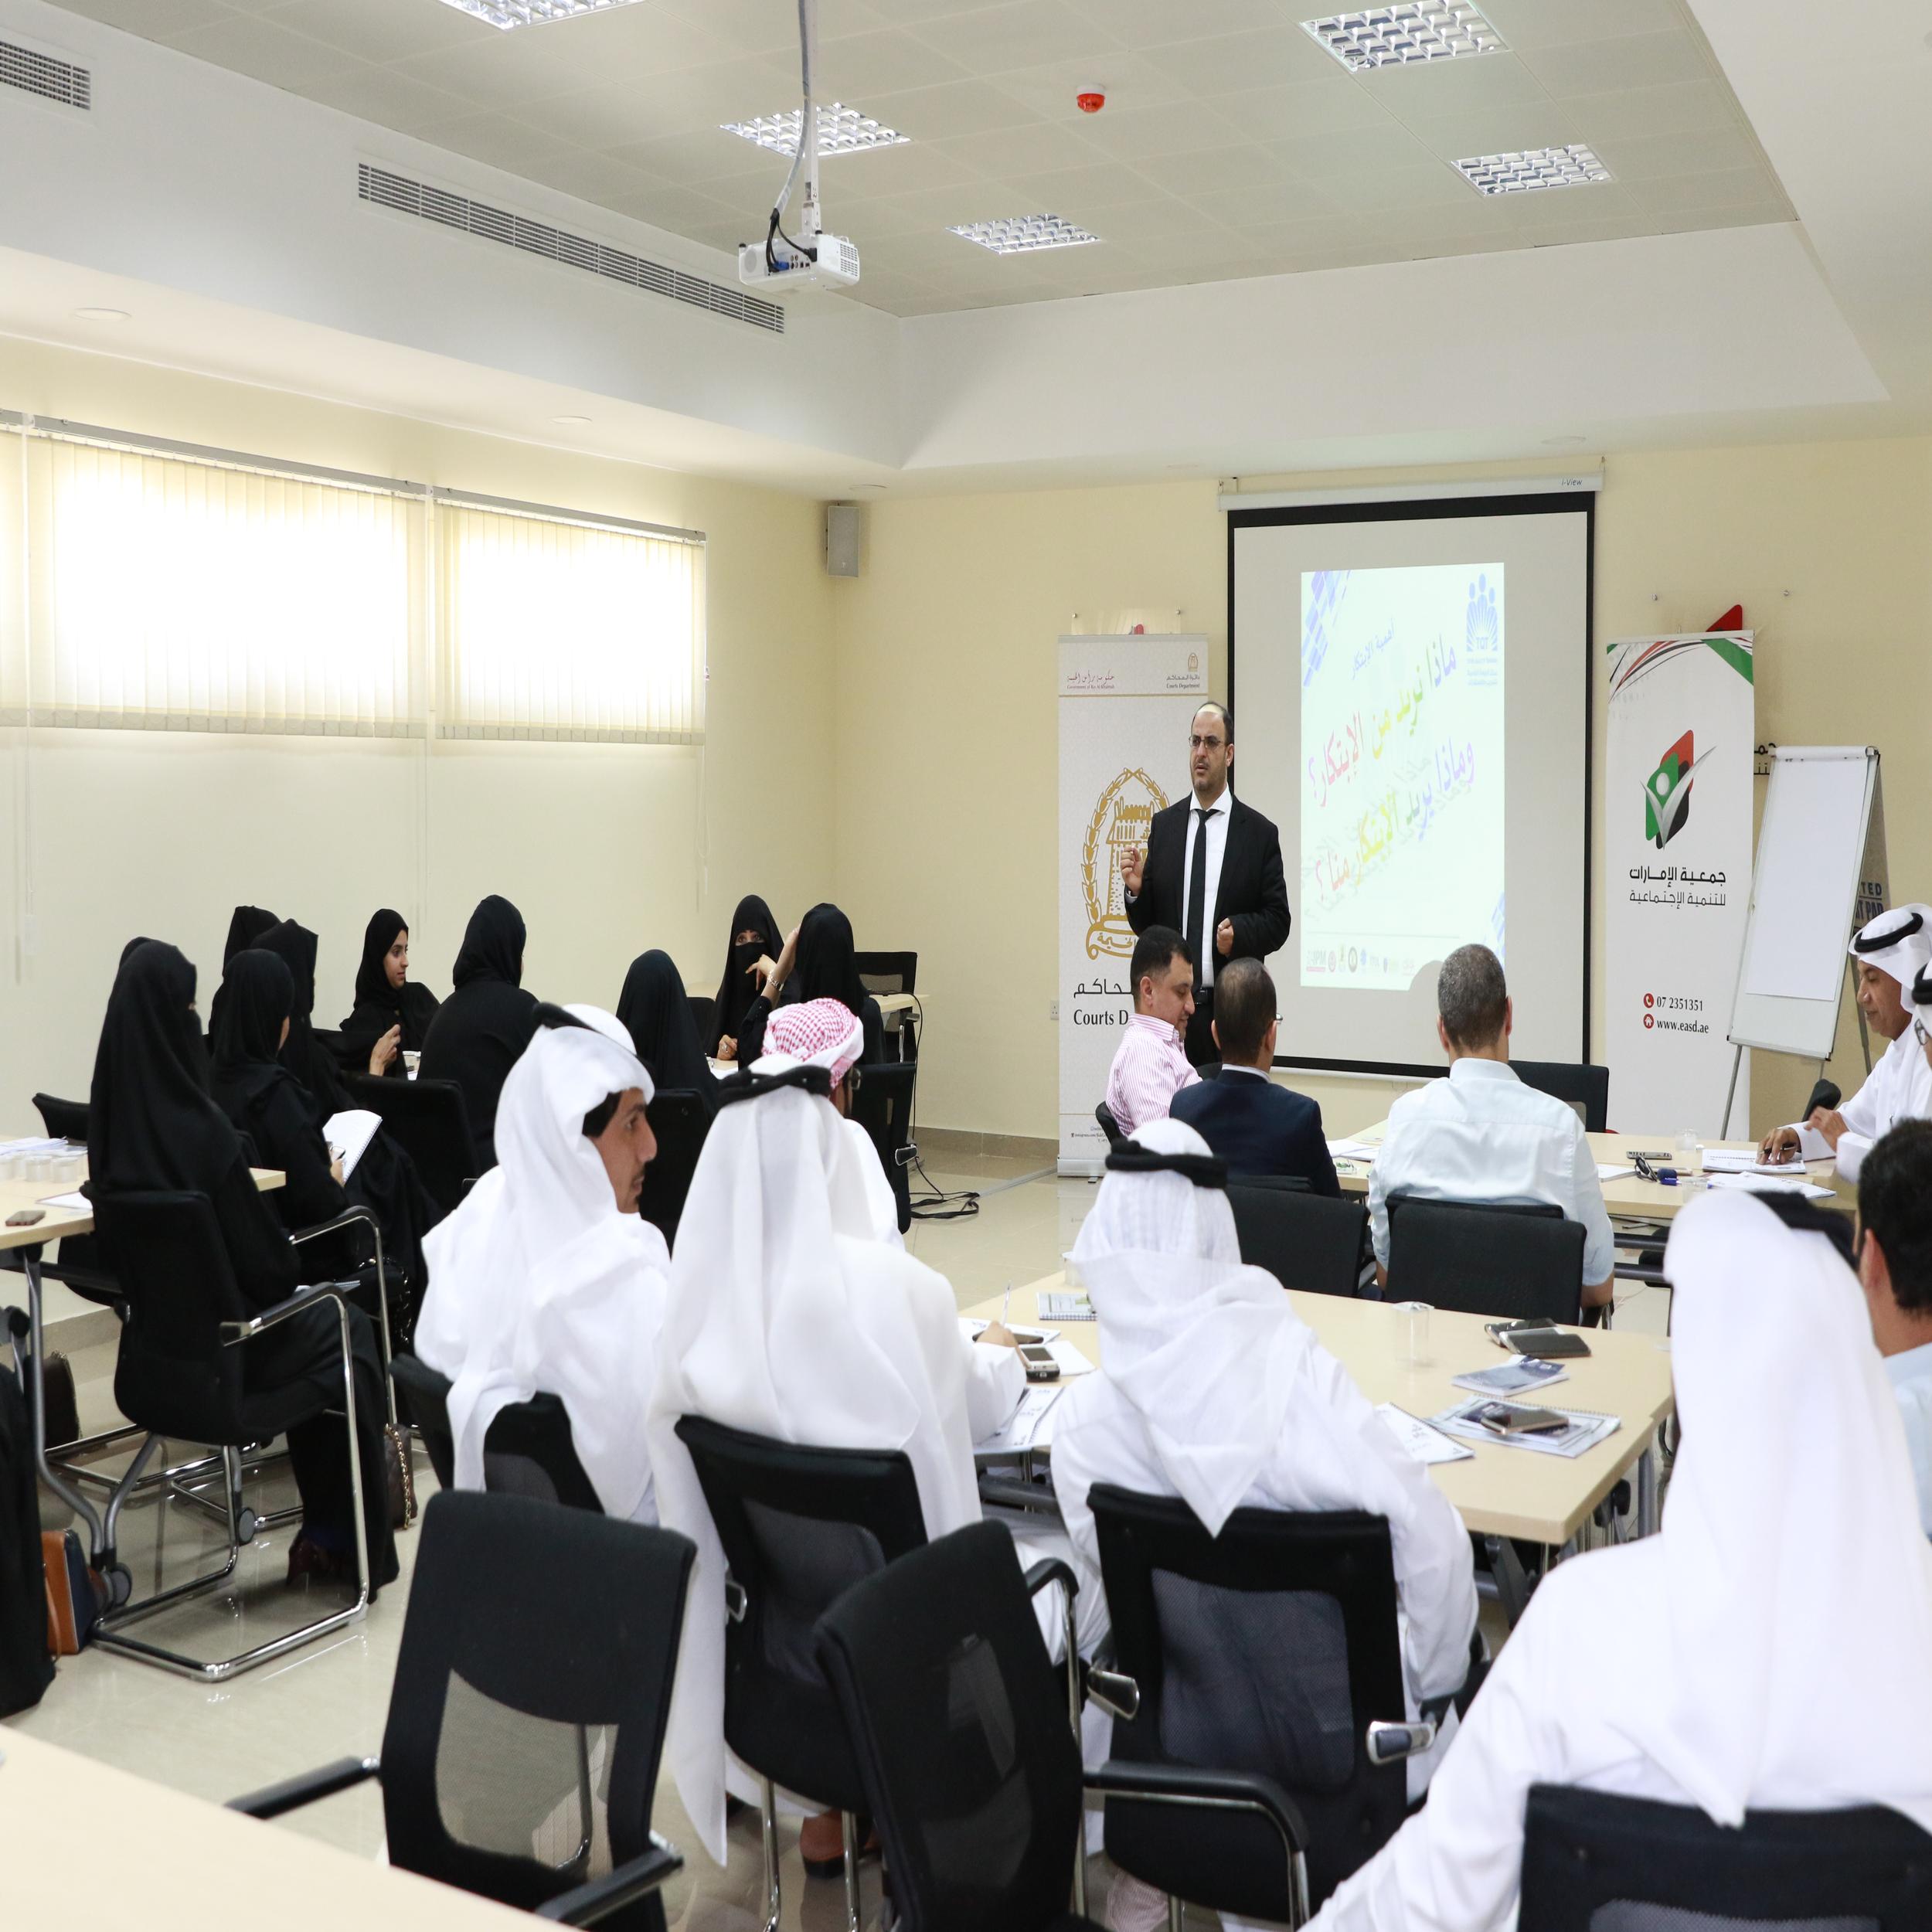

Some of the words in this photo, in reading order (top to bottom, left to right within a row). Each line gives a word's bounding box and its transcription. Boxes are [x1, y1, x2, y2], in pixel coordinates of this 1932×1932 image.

[1629, 865, 1678, 888] الإمارات
[1680, 866, 1726, 887] جمعية
[1629, 889, 1685, 910] الإجتماعية
[1687, 892, 1726, 907] للتنمية
[1656, 995, 1667, 1008] 07
[1668, 997, 1703, 1012] 2351351
[1073, 1009, 1114, 1026] Courts
[1656, 1019, 1709, 1034] www.easd.ae
